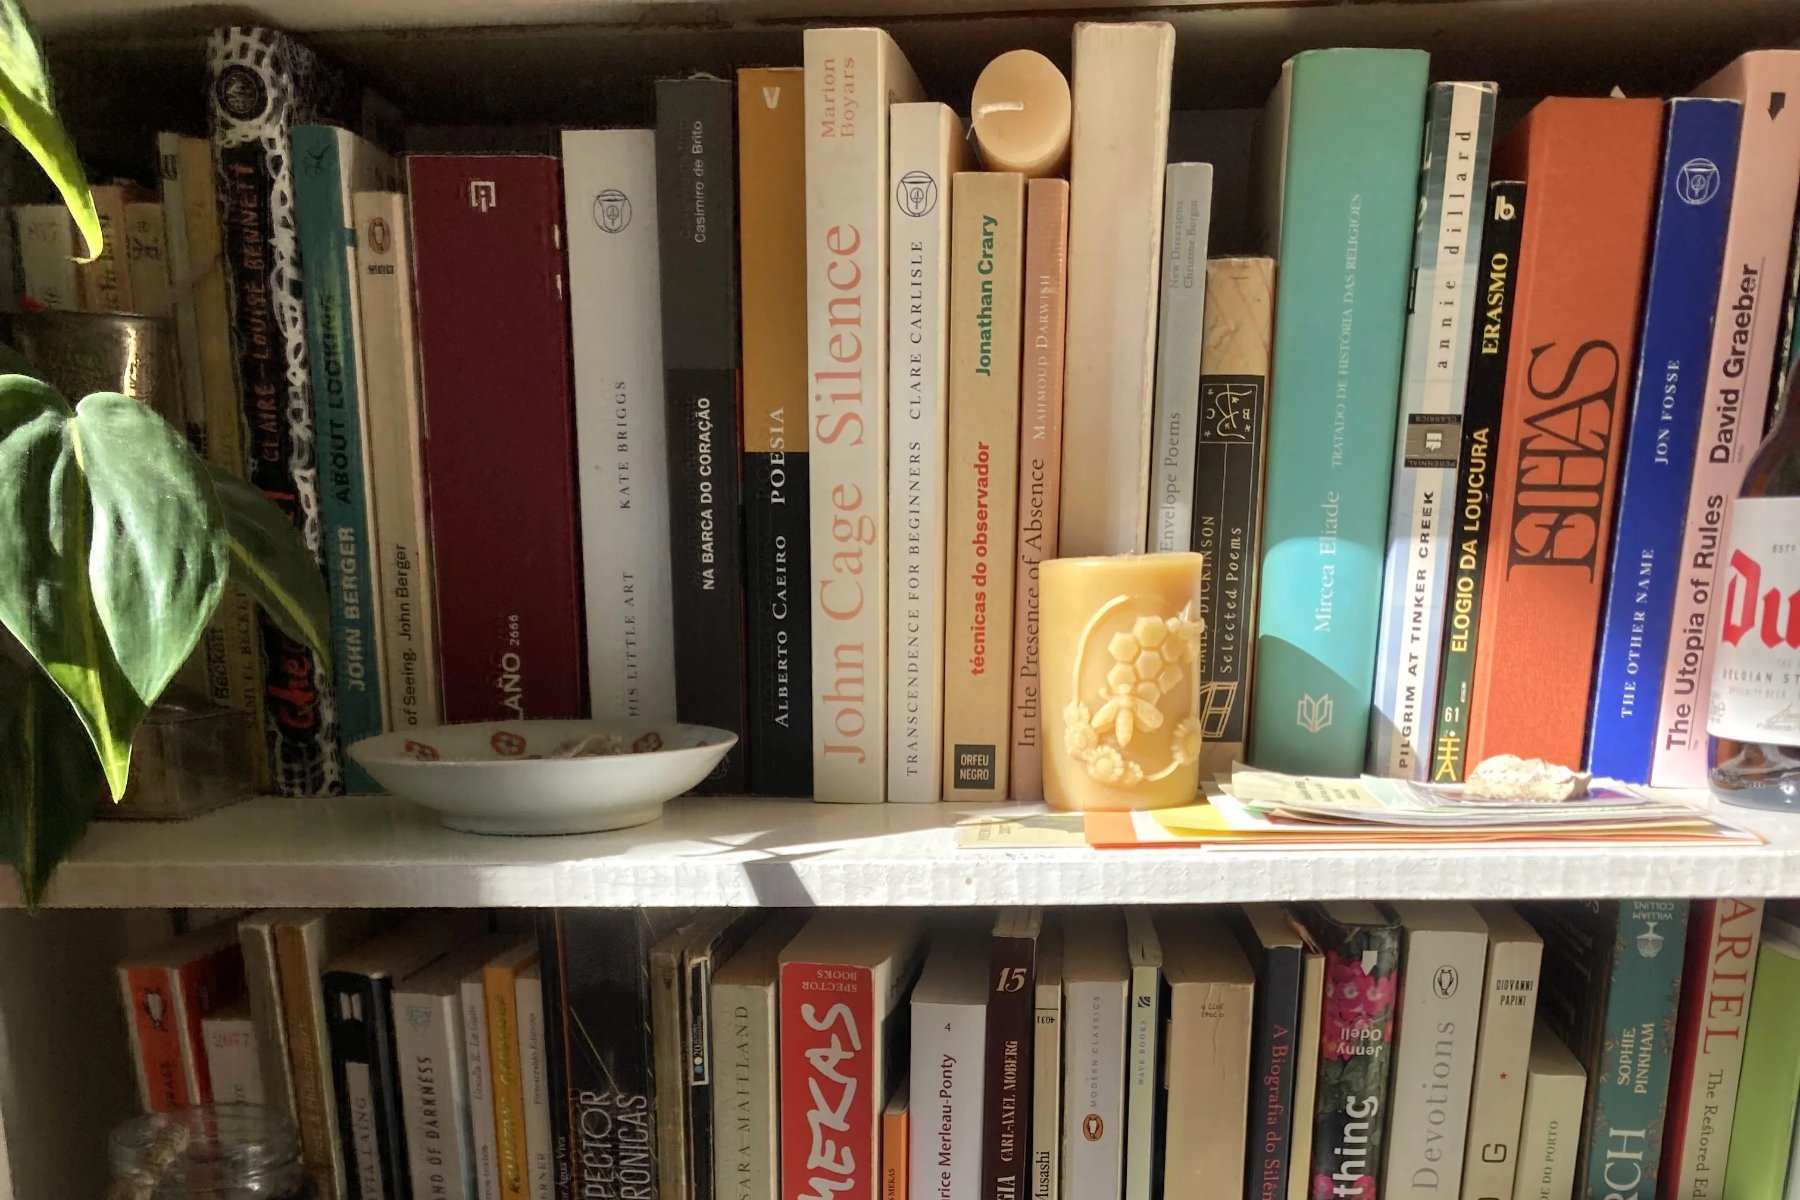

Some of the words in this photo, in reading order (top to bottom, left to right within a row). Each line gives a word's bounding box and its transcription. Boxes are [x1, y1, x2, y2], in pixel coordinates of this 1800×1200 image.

[1441, 130, 1472, 254] dillard
[977, 214, 998, 276] Crary
[909, 240, 923, 344] CARLISLE
[1434, 281, 1456, 369] annie
[1481, 252, 1509, 354] ERASMO
[1721, 264, 1759, 379] Graeber
[815, 225, 864, 447] Silence
[975, 281, 995, 376] Jonathan
[615, 380, 627, 452] BRIGGS
[909, 354, 921, 420] CLARE
[1659, 359, 1680, 420] FOSSE
[694, 397, 714, 478] CORAÇÃO
[768, 407, 786, 504] POESIA
[1654, 428, 1671, 464] JON
[1708, 388, 1741, 464] David
[617, 461, 631, 509] KATE
[698, 482, 713, 504] DO
[907, 441, 922, 555] BEGINNERS
[971, 442, 990, 558] observador
[1461, 428, 1490, 532] LOUCURA
[698, 509, 714, 564] BARCA
[819, 483, 876, 621] Cage
[1225, 526, 1243, 582] Poems
[1319, 491, 1341, 556] Eliade
[1416, 490, 1434, 558] CREEK
[1456, 541, 1478, 569] DA
[1692, 495, 1725, 570] Rules
[337, 527, 360, 619] BERGER
[392, 545, 411, 598] Berger
[700, 568, 716, 590] NA
[771, 535, 788, 619] CAEIRO
[907, 563, 921, 601] FOR
[971, 563, 988, 585] do
[1313, 564, 1337, 633] Mircea
[1411, 569, 1427, 643] TINKER
[1638, 549, 1654, 603] NAME
[1685, 577, 1709, 604] of
[397, 603, 412, 641] John
[970, 590, 988, 676] técnicas
[1219, 589, 1238, 673] Selected
[1450, 576, 1475, 652] ELOGIO
[1625, 610, 1646, 675] OTHER
[343, 626, 365, 692] JOHN
[774, 630, 790, 727] ALBERTO
[1408, 653, 1418, 676] AT
[1674, 612, 1708, 696] Utopia
[405, 710, 419, 725] of
[820, 642, 867, 764] John
[906, 609, 920, 776] TRANSCENDENCE
[1399, 686, 1416, 768] PILGRIM
[1621, 682, 1637, 718] THE
[1665, 703, 1693, 751] The
[960, 768, 989, 779] NEGRO
[961, 755, 990, 765] ORFEU
[735, 1005, 751, 1132] MAITLAND
[1004, 1040, 1019, 1091] MOBERG
[1617, 1028, 1635, 1086] SOPHIE
[1634, 1023, 1655, 1094] PINKHAM
[938, 1054, 957, 1167] Merleau-Ponty
[1000, 1095, 1016, 1161] CARL-AXEL
[1411, 1021, 1456, 1192] Devotions
